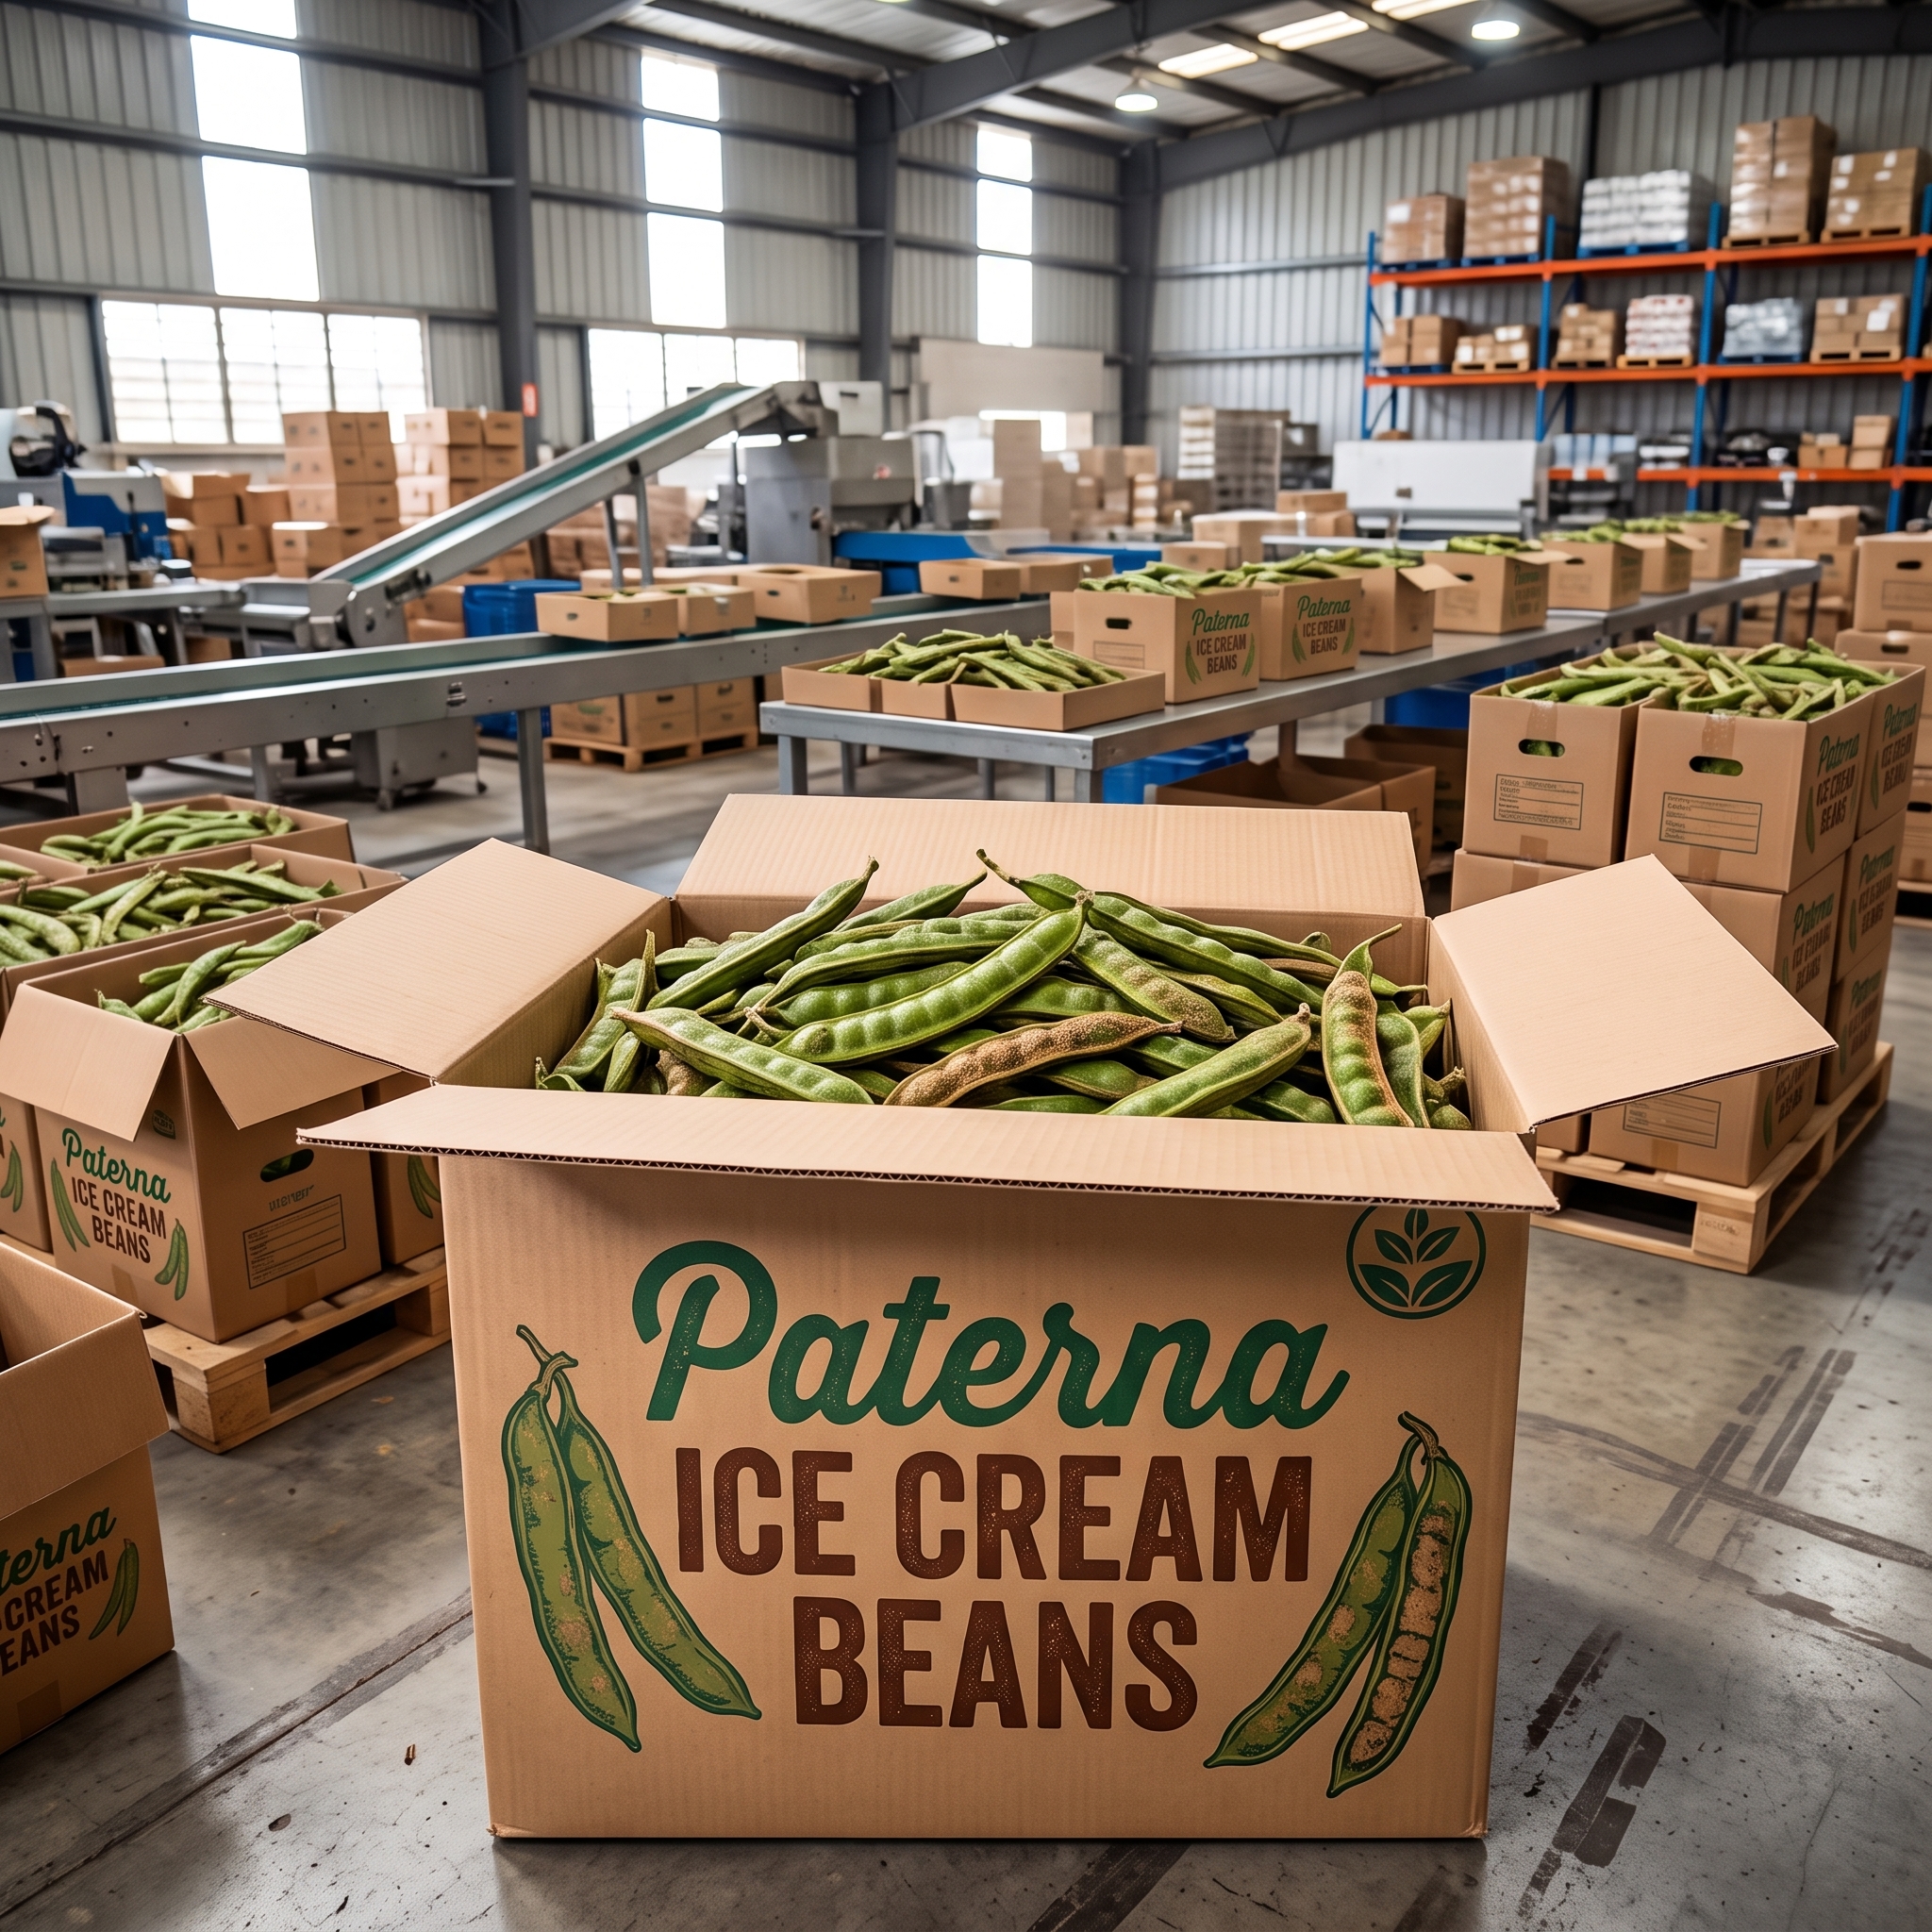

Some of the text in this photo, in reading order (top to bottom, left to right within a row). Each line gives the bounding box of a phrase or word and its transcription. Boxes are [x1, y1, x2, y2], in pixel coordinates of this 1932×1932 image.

[1191, 608, 1250, 636] Paterna
[1297, 595, 1351, 620] Paterna
[1303, 619, 1346, 638] ICE CREAM
[1196, 634, 1246, 656] ICE CREAM
[1207, 654, 1238, 675] BEANS
[1310, 637, 1338, 655] BEANS
[61, 1127, 172, 1204] Paterna
[71, 1176, 166, 1240] ICE CREAM
[92, 1215, 152, 1264] BEANS
[632, 1240, 1351, 1430] Paterna
[675, 1447, 1312, 1583] ICE CREAM
[4, 1550, 109, 1631] CREAM
[792, 1596, 1198, 1732] BEANS
